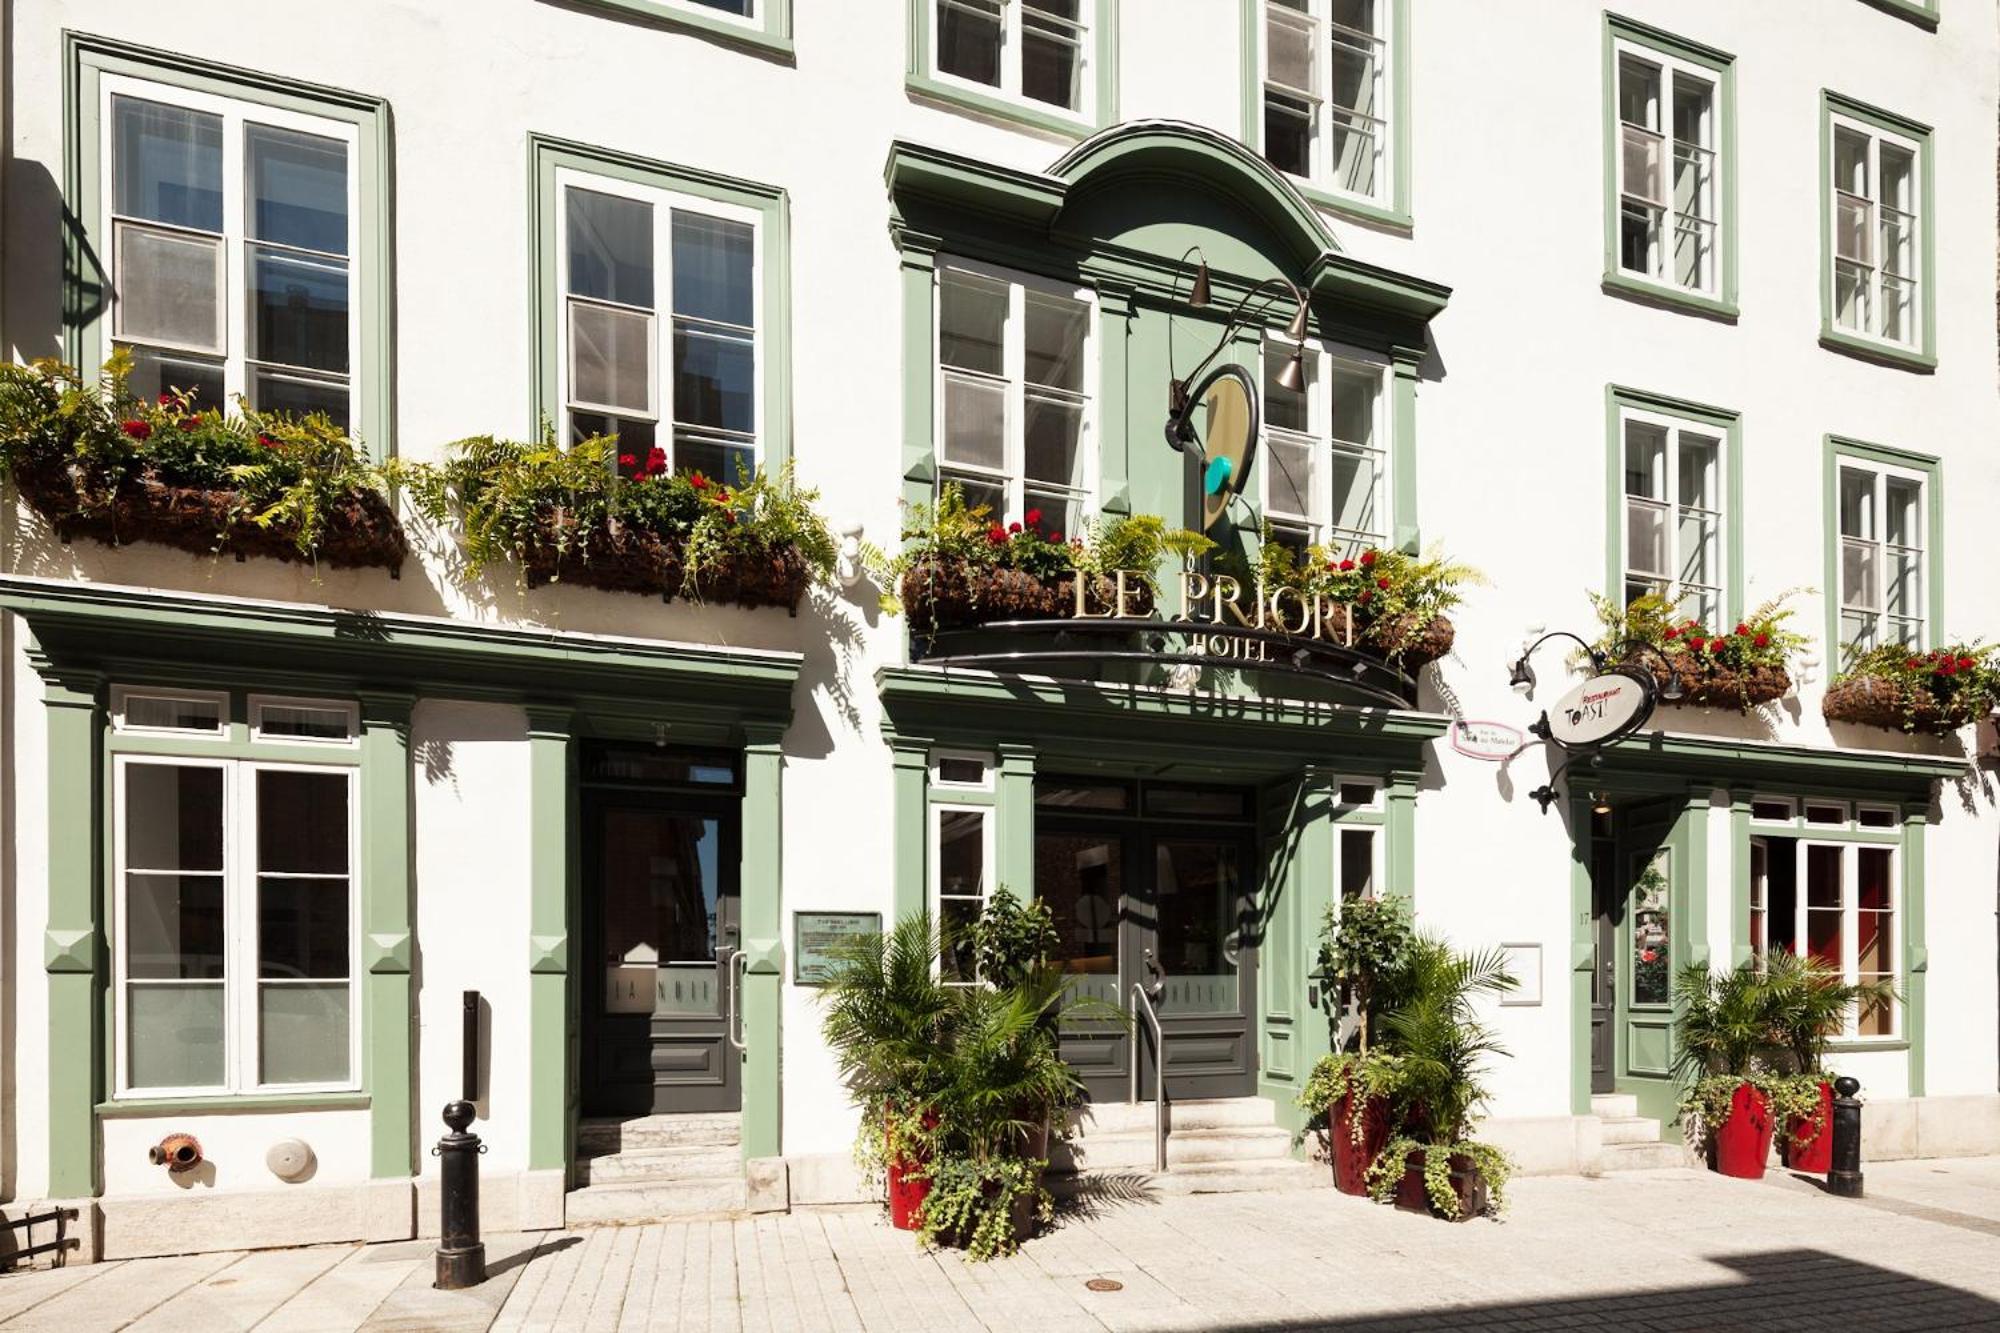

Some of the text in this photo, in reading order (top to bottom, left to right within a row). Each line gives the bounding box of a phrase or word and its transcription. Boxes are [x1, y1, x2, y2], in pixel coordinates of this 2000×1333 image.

[1072, 568, 1154, 619] LE
[1175, 572, 1353, 648] PRIORI
[1191, 633, 1275, 663] HOTEL
[1565, 698, 1608, 727] TOAST!
[1580, 912, 1590, 926] 17
